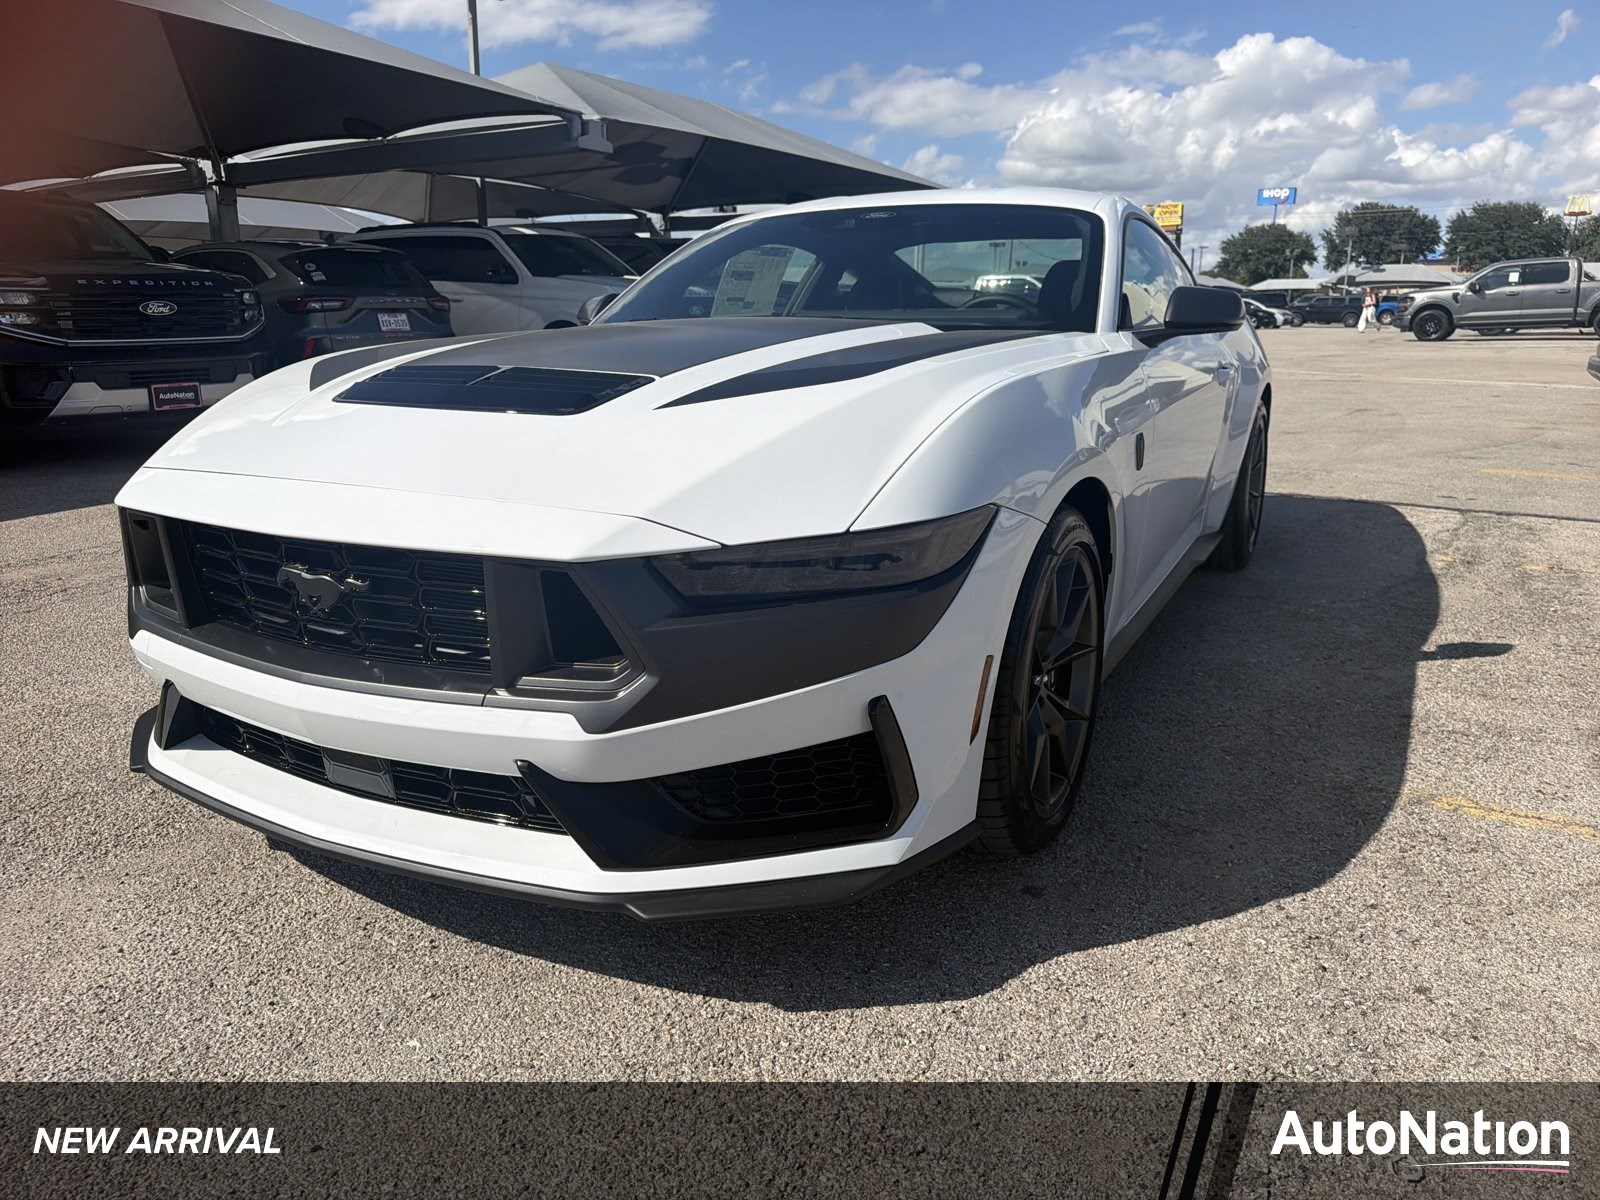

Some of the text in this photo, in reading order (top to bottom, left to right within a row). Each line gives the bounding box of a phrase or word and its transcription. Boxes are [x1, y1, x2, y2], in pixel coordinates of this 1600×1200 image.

[77, 279, 214, 287] EXPEDITION
[147, 303, 170, 313] Ford
[159, 391, 195, 400] AutoNation
